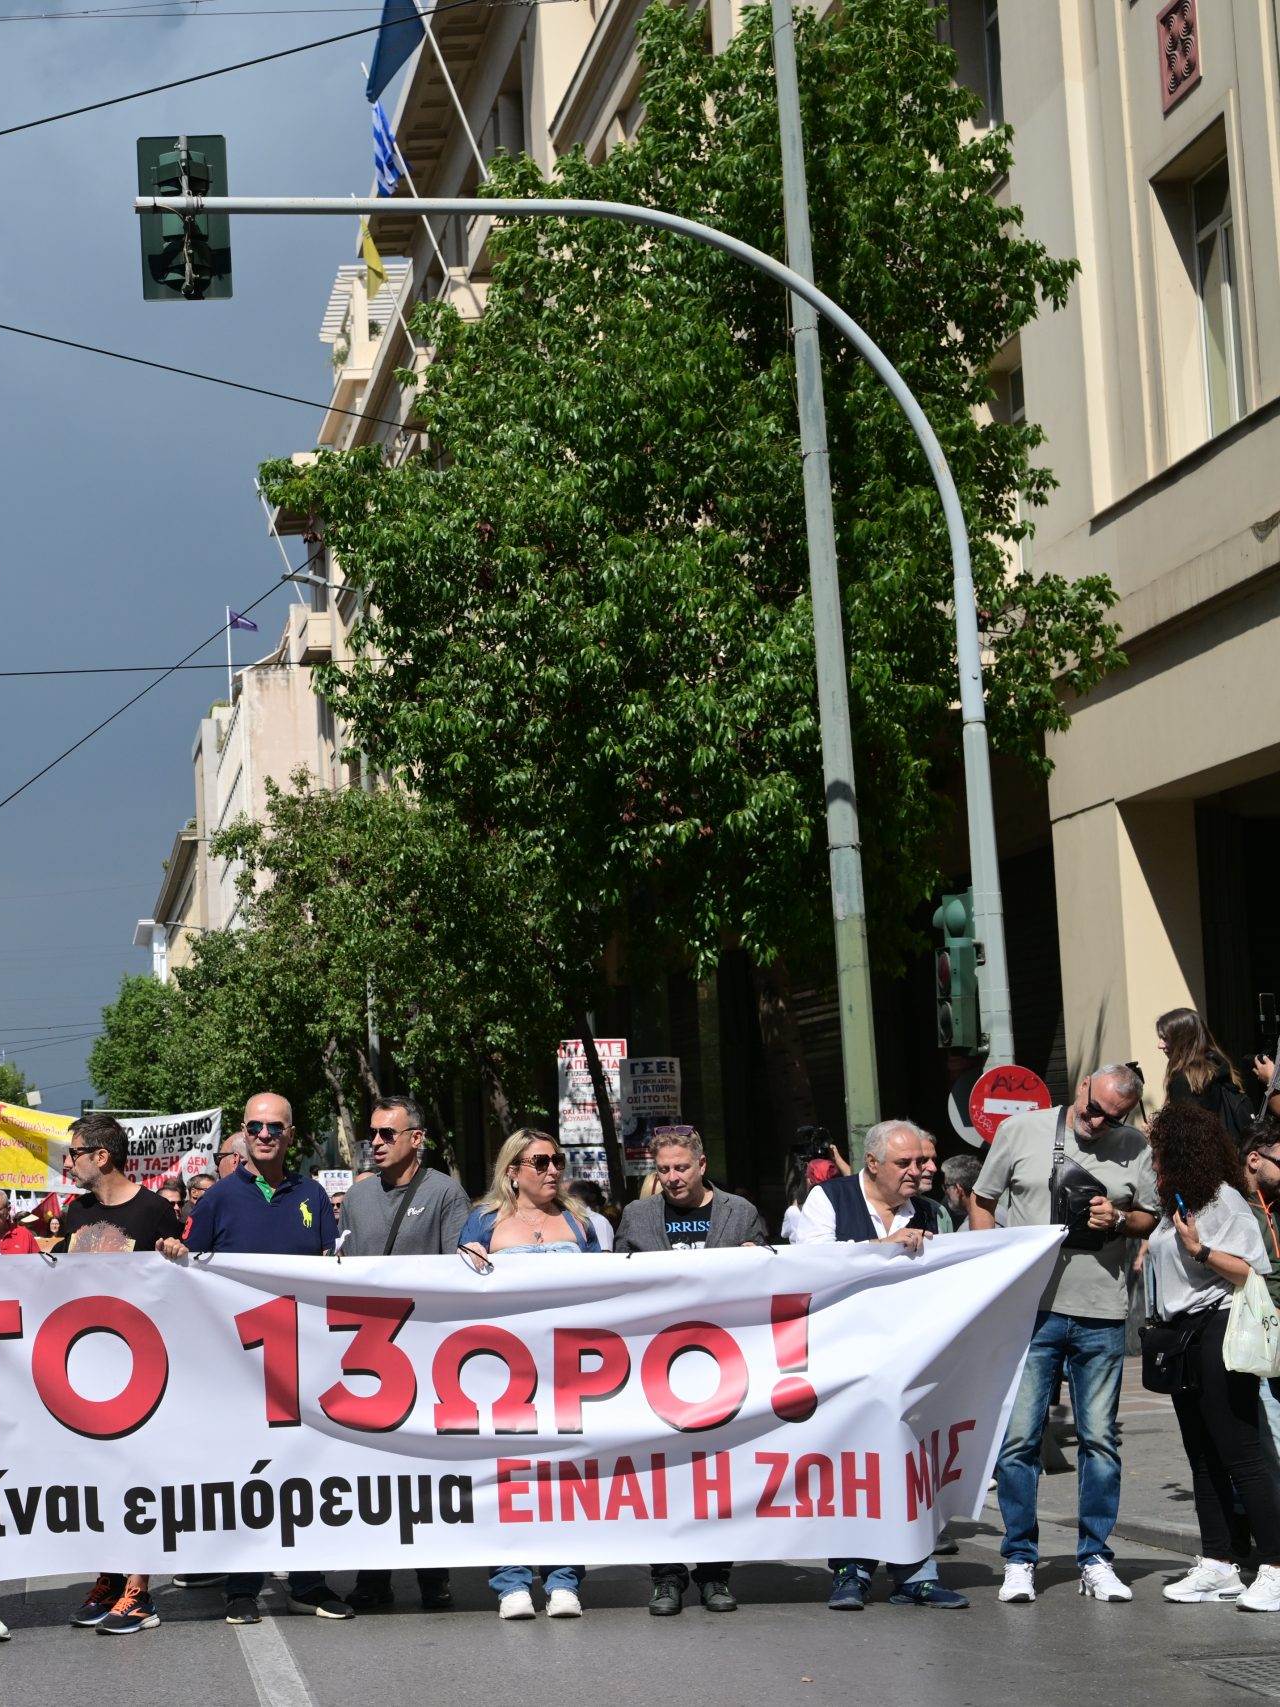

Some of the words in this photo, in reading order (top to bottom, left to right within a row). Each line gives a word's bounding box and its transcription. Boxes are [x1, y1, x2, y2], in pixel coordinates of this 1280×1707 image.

[566, 1060, 620, 1070] ΑΠΕΓΙΑ
[630, 1061, 675, 1075] ΓΣΕΕ
[187, 1157, 207, 1166] ΔΕΝ
[570, 1151, 608, 1161] ΓΣΕ
[234, 1292, 819, 1436] 13ΩΡΟ!
[123, 1458, 474, 1552] εμπόρευμα
[497, 1452, 669, 1524] ΕΙΝΑΙ
[692, 1451, 732, 1521] Η
[755, 1451, 882, 1519] ΖΩΗ
